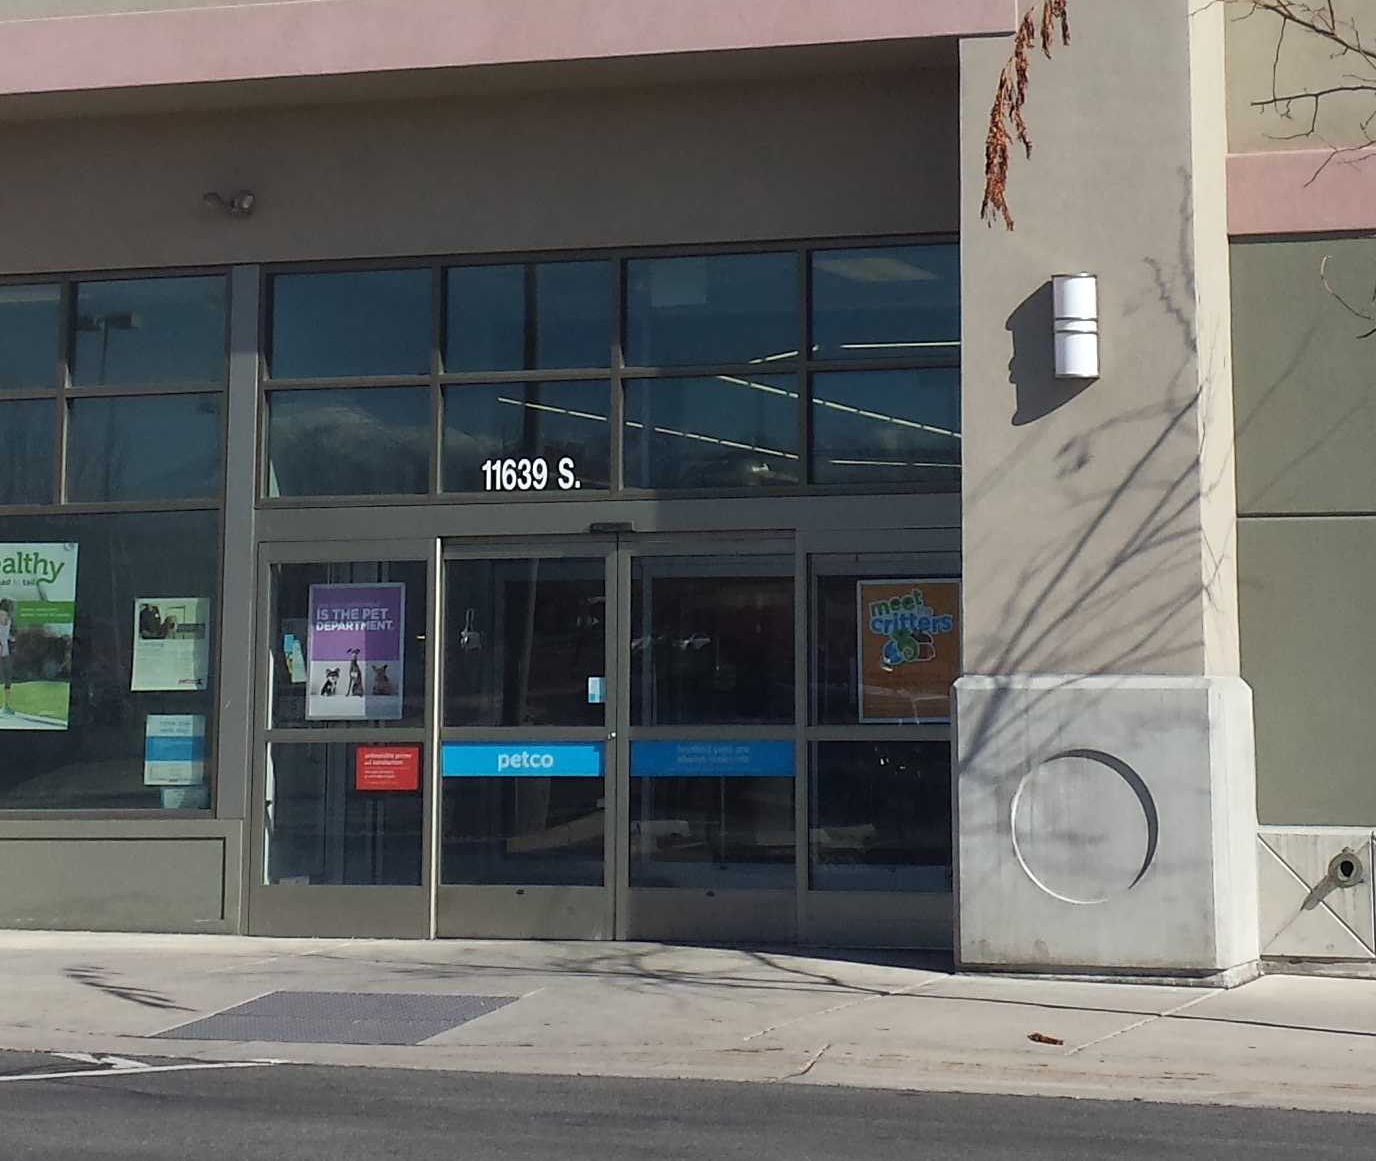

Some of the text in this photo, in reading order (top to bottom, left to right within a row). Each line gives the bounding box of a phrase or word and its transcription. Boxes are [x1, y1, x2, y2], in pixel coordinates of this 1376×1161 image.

[482, 457, 581, 491] 11639 S.
[316, 608, 389, 620] IS THE PET
[869, 589, 923, 617] meet
[870, 612, 953, 635] critters
[498, 751, 554, 772] petco
